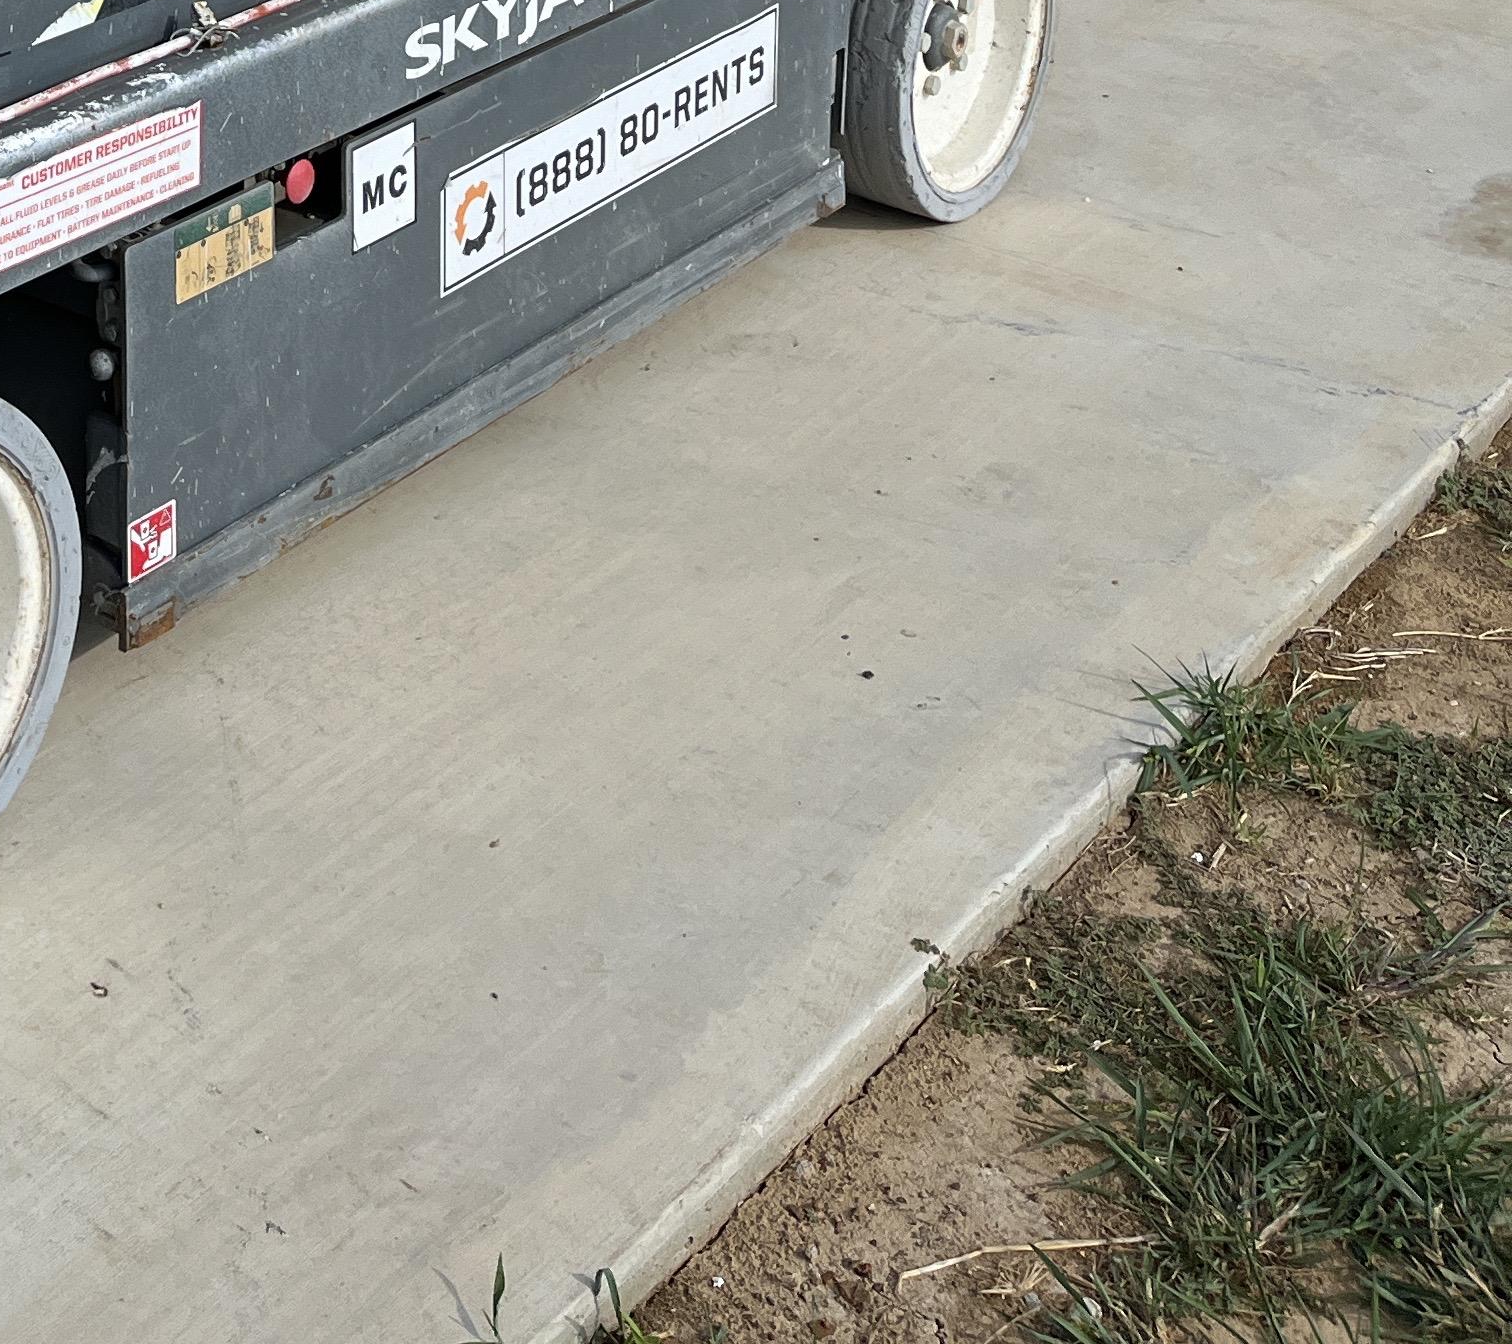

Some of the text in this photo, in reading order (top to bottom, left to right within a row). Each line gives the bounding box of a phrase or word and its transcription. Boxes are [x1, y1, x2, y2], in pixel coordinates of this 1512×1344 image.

[21, 106, 199, 190] CUSTOMER RESPONSIBILITY
[515, 45, 766, 219] (888) 80-RENTS
[0, 213, 14, 227] ALL
[40, 191, 68, 211] LEVELS
[76, 176, 105, 194] GREASE
[106, 167, 129, 182] DAILY
[36, 215, 55, 229] FLAT
[56, 204, 80, 222] TIRES
[85, 195, 105, 209] TIRE
[104, 180, 136, 200] DAMAGE
[362, 164, 408, 215] MC
[3, 250, 14, 261] TO
[15, 229, 62, 257] EQUIPMENT
[67, 212, 101, 235] BATTERY
[101, 188, 155, 219] MAINTENANCE
